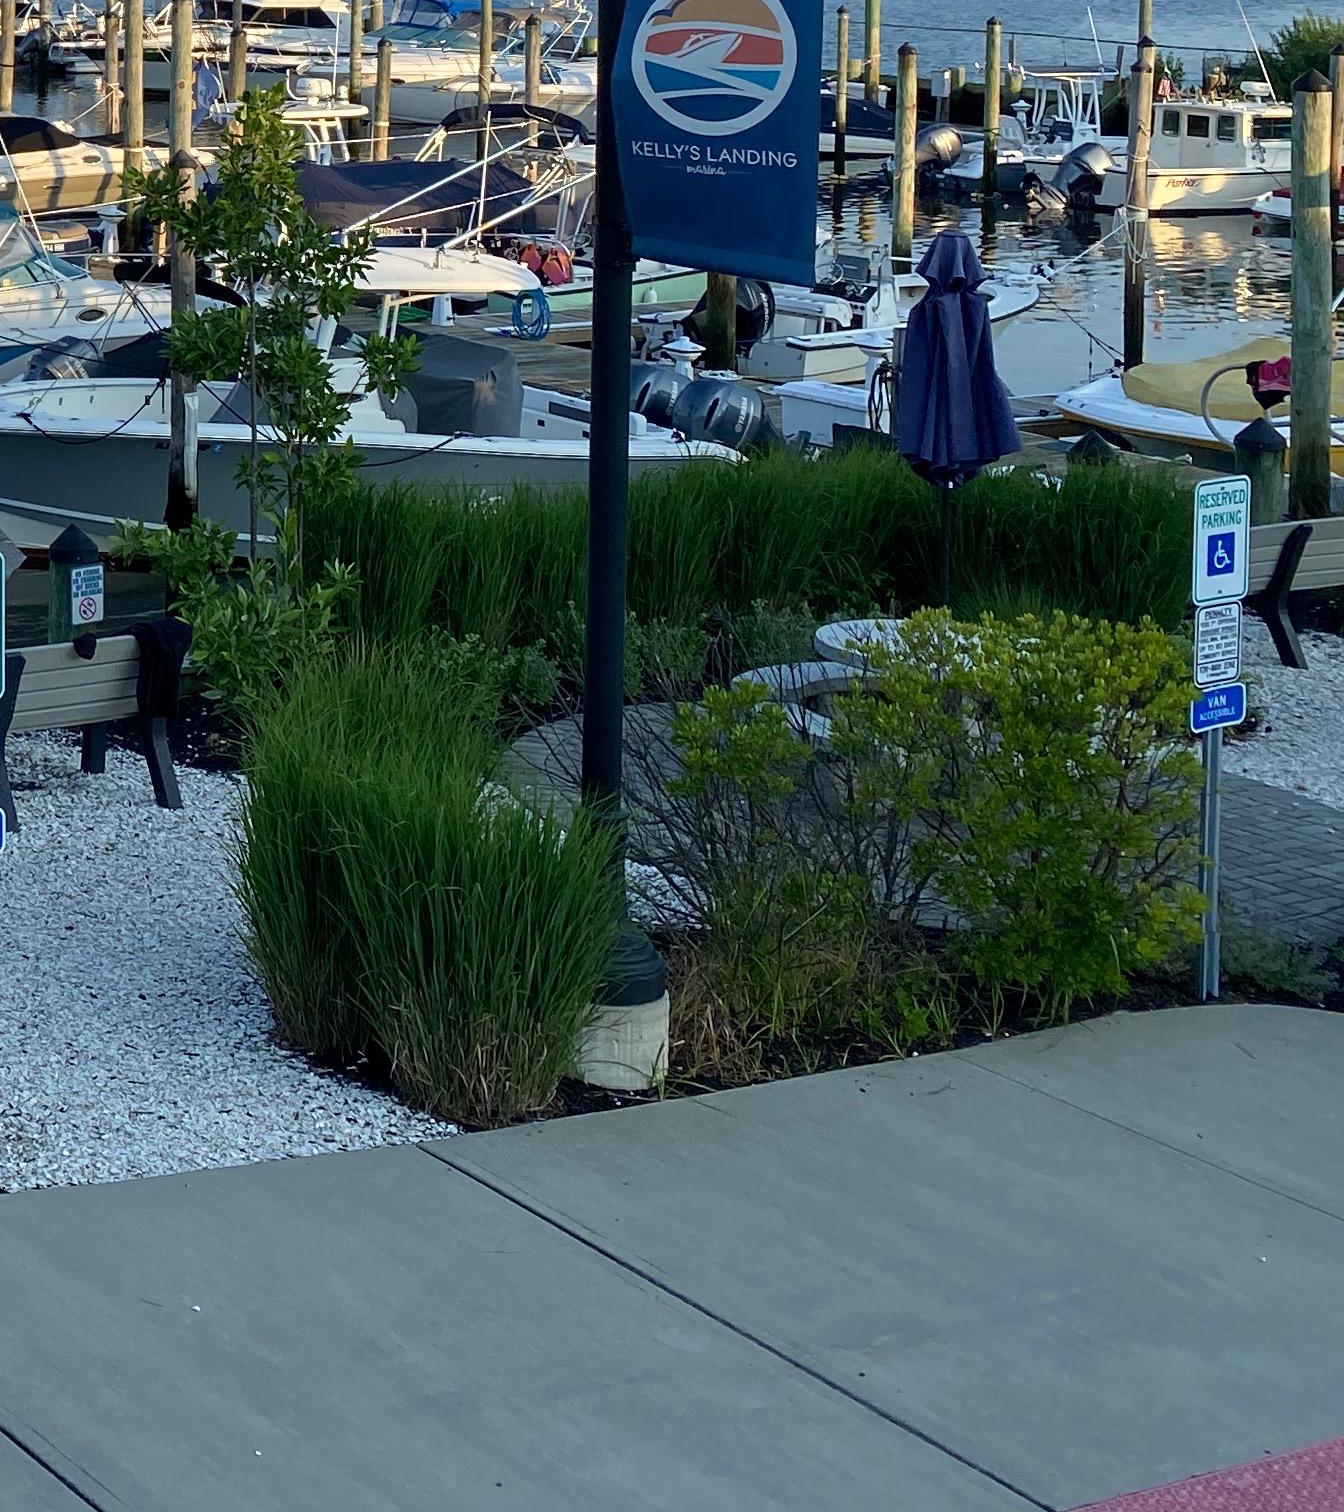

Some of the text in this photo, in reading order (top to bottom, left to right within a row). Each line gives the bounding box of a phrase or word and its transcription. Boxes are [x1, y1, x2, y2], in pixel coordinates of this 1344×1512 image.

[632, 140, 797, 168] KELLY'S LANDING
[686, 165, 727, 175] marina
[1200, 489, 1245, 509] RESERVED
[1202, 510, 1242, 529] PARKING
[1207, 694, 1226, 708] VAN
